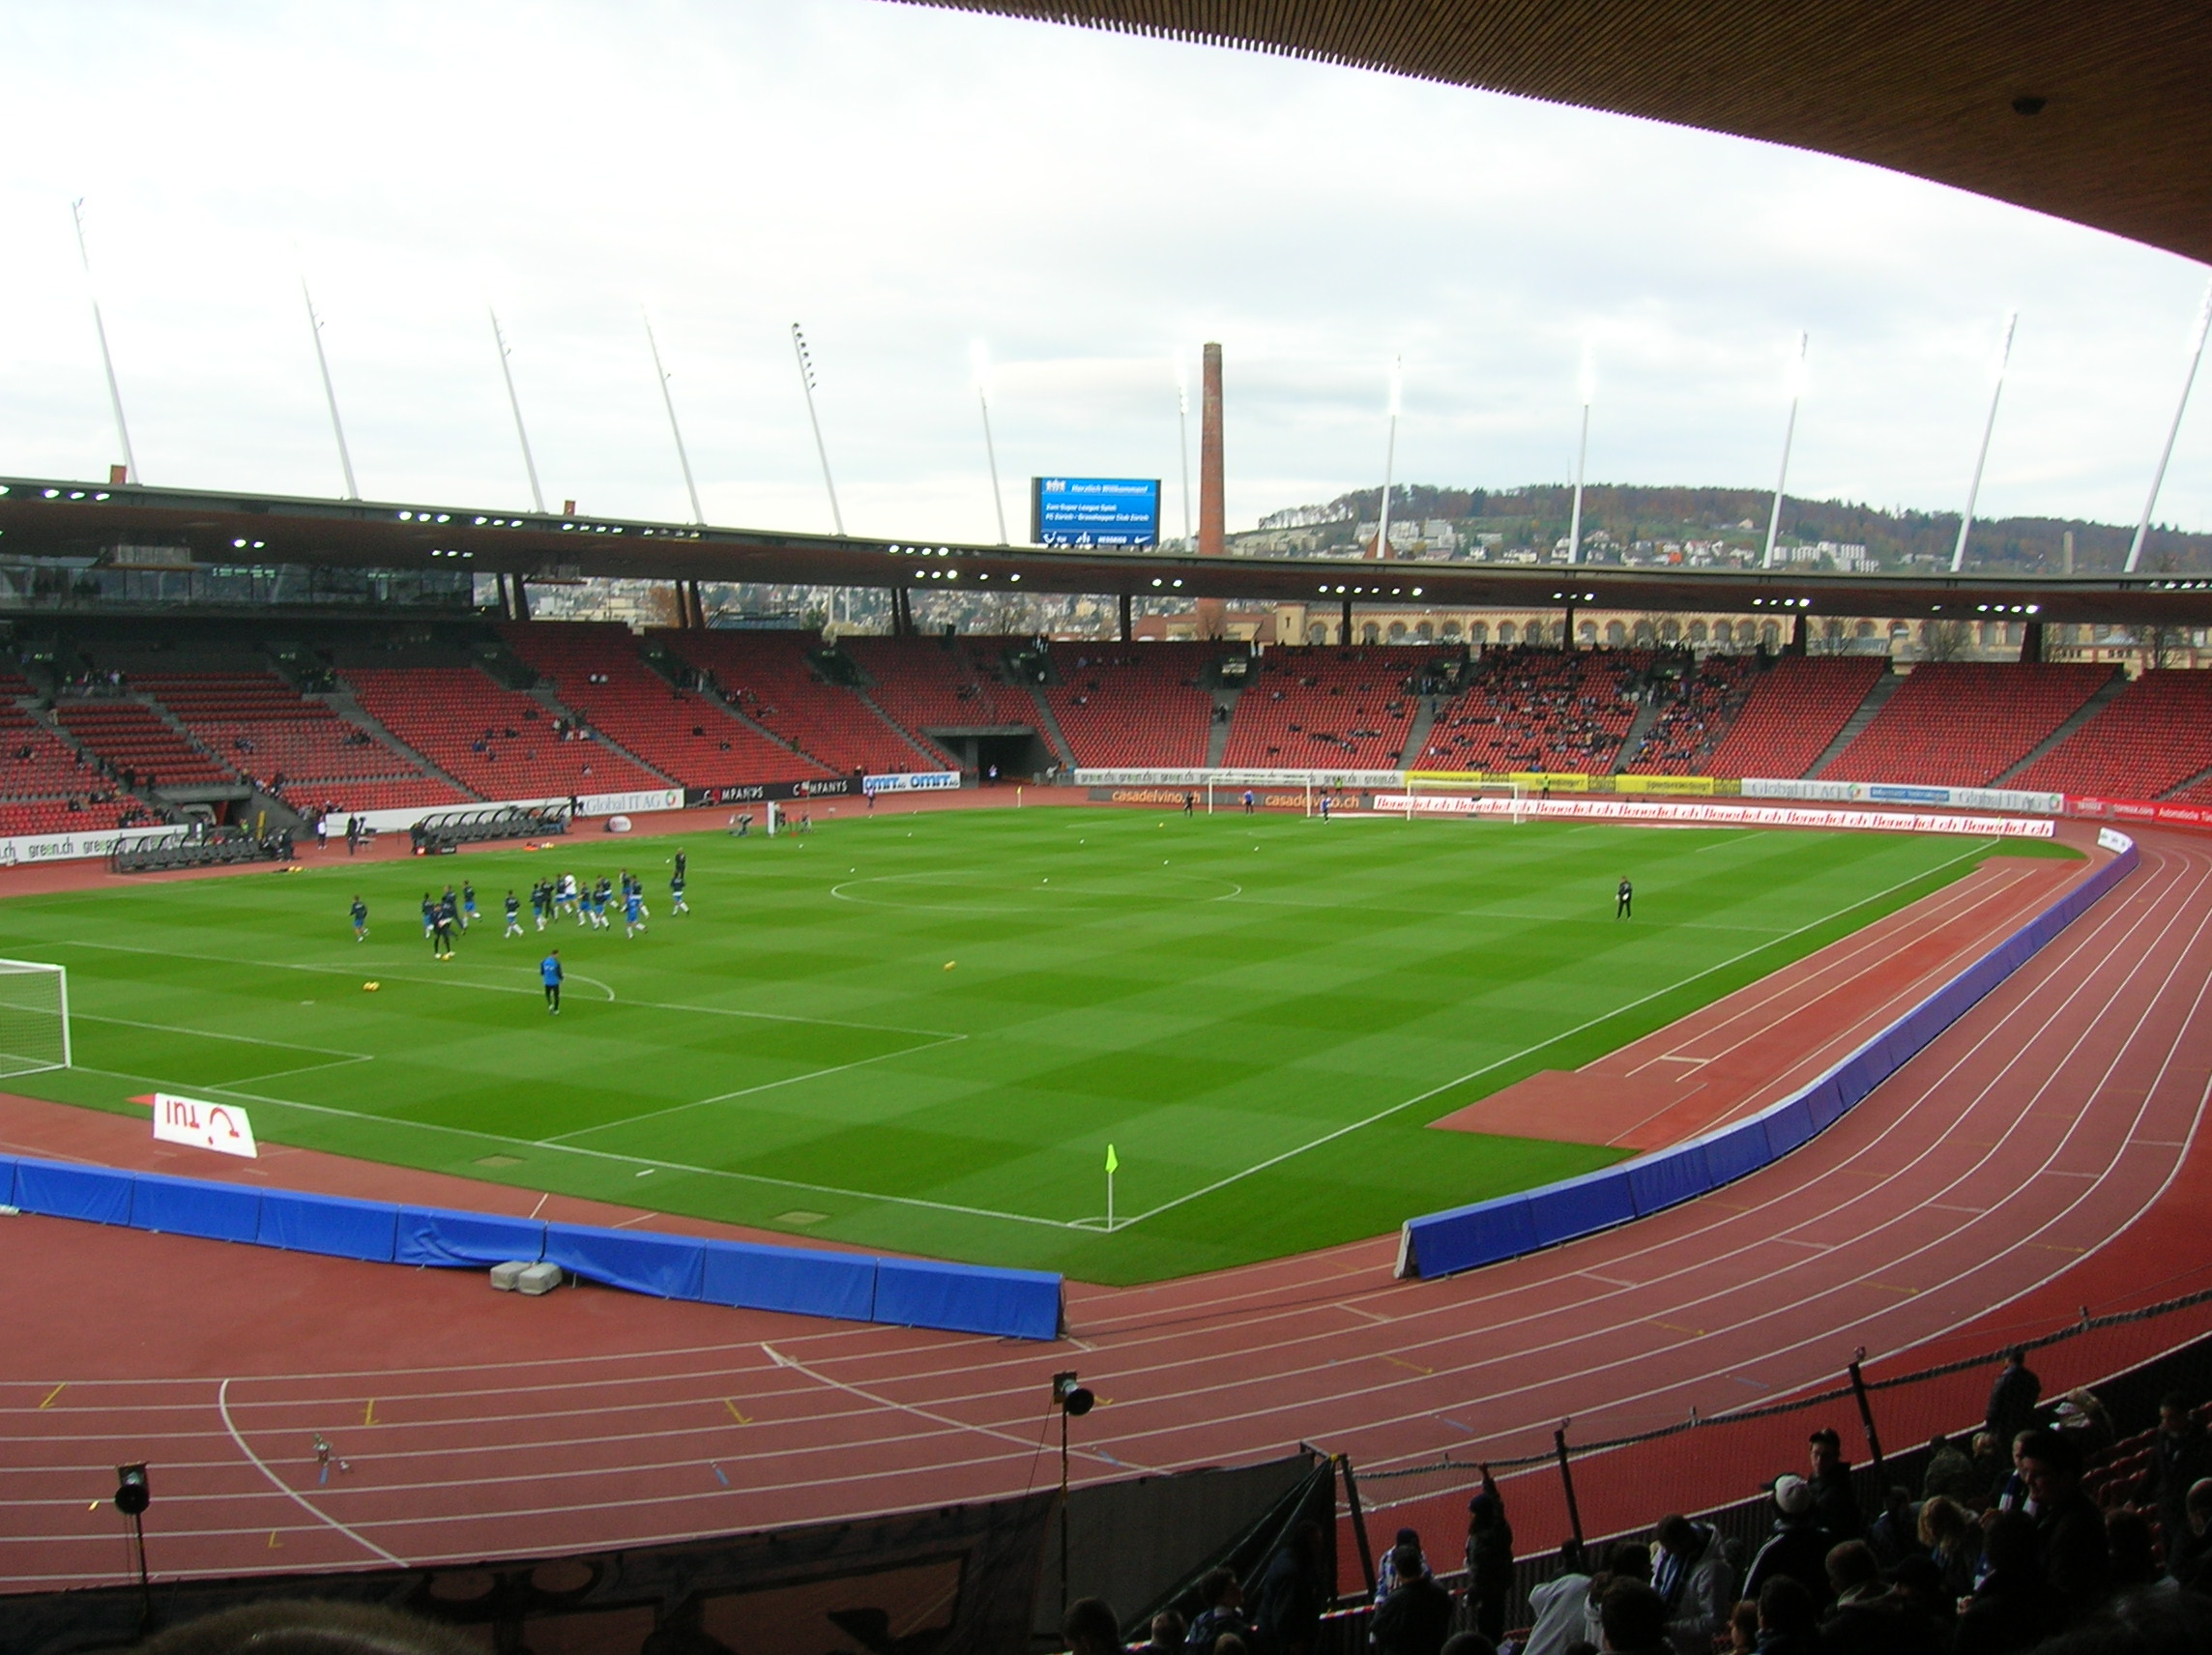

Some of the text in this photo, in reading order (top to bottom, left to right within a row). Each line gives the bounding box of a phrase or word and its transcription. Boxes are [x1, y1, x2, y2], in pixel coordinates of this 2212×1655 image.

[587, 794, 626, 814] Global
[642, 793, 660, 808] AG
[1112, 788, 1201, 805] casadelvino.h
[1265, 793, 1360, 809] casadevo.ch
[28, 836, 73, 858] green.ch
[166, 1099, 200, 1129] TUI
